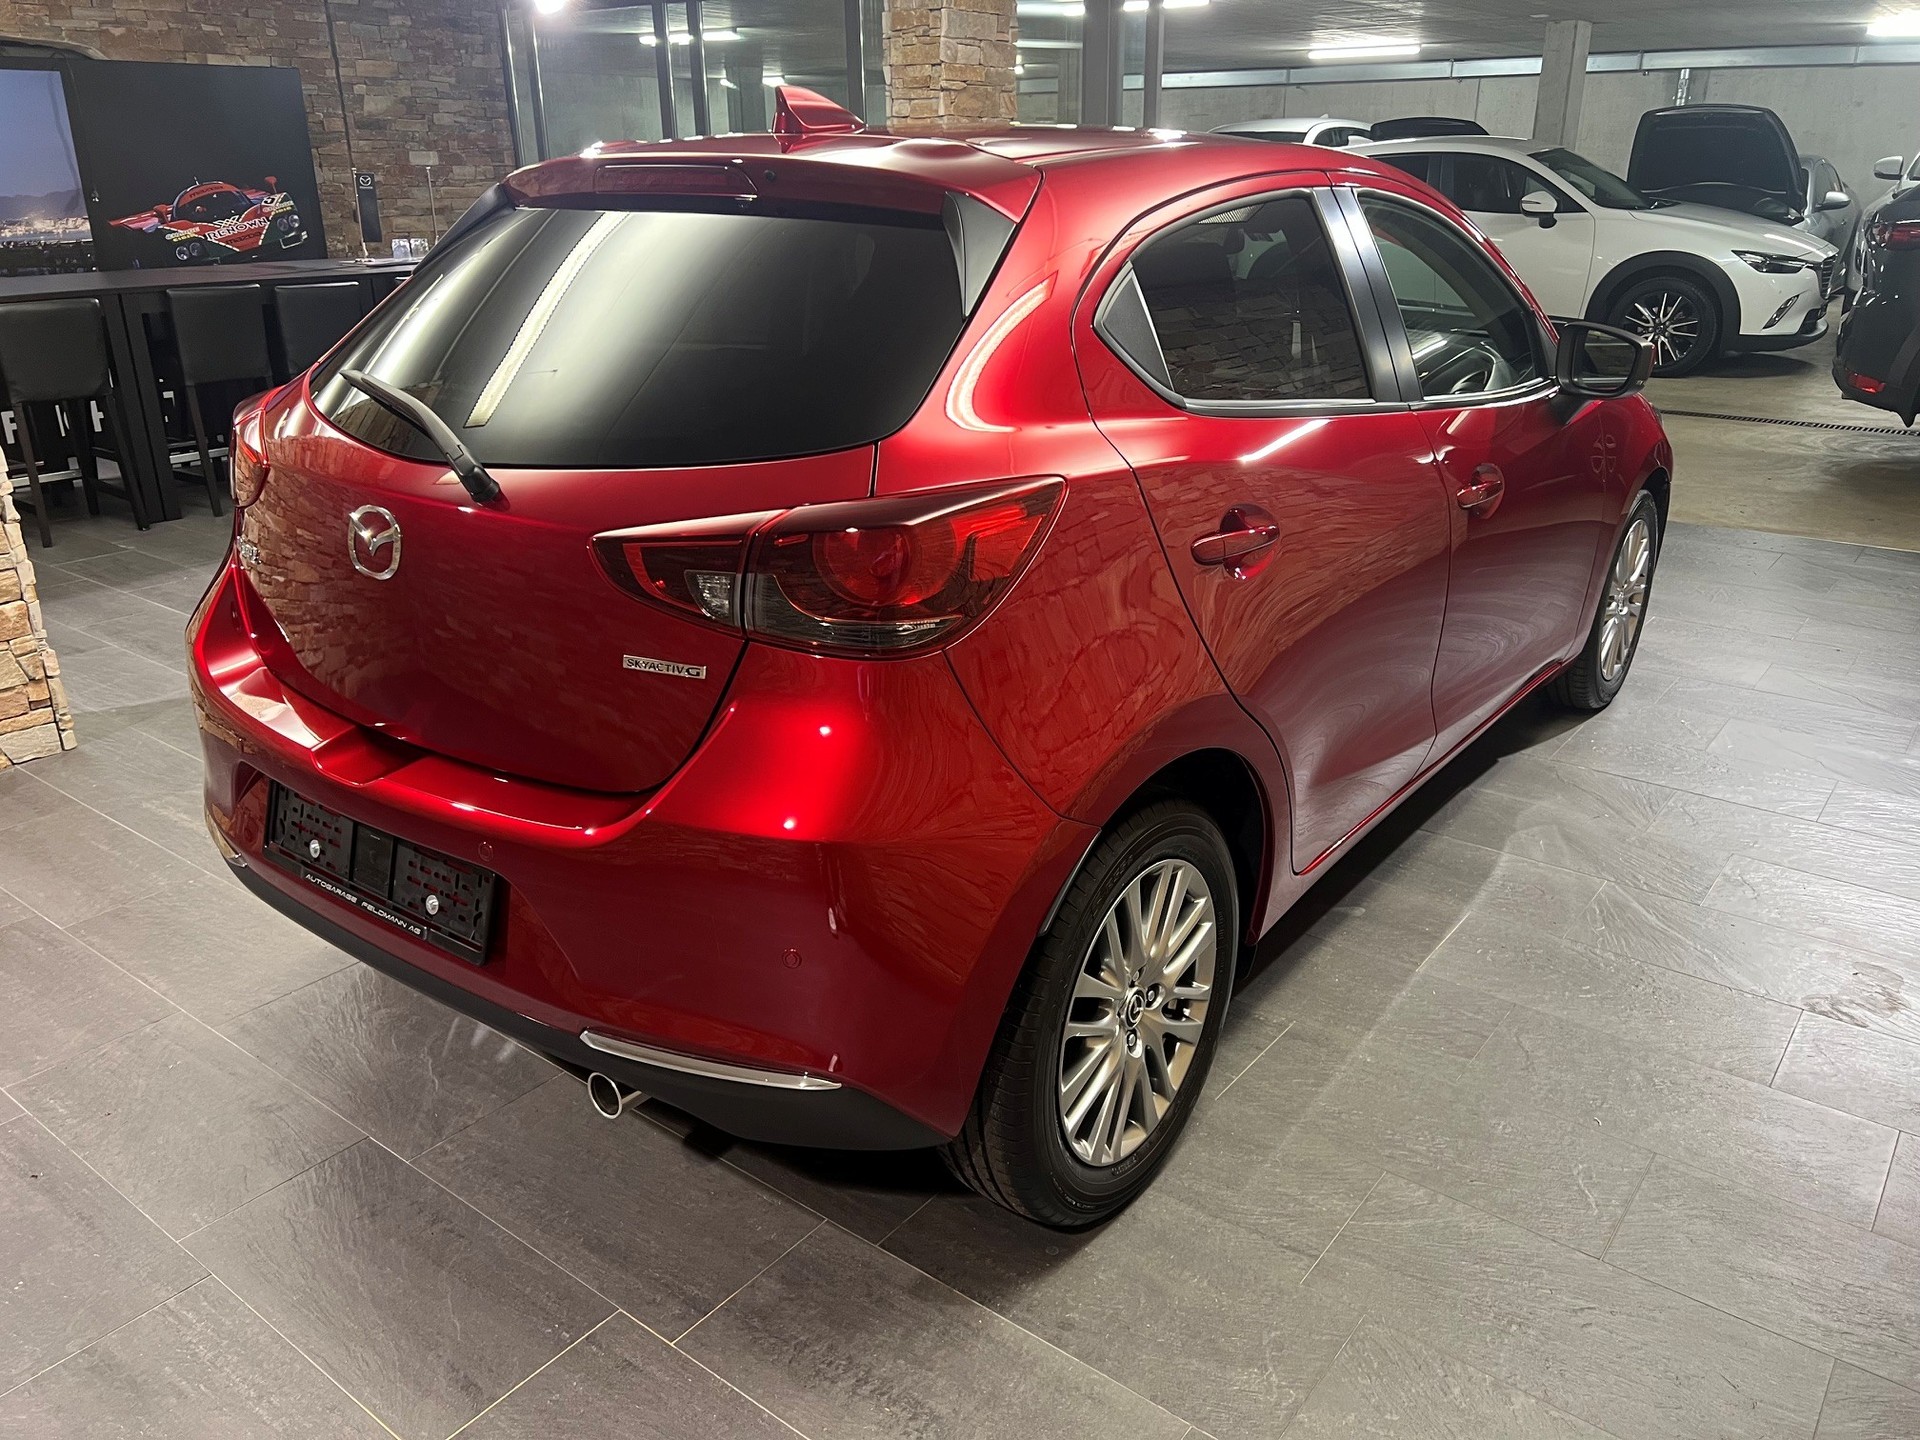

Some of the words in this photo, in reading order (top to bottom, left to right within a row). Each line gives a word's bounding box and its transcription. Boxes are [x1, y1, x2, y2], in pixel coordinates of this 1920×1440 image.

[205, 217, 270, 241] RENOWN
[305, 873, 358, 904] AUTOGARAGE
[361, 901, 408, 929] FELDMANN
[408, 925, 422, 935] AG
